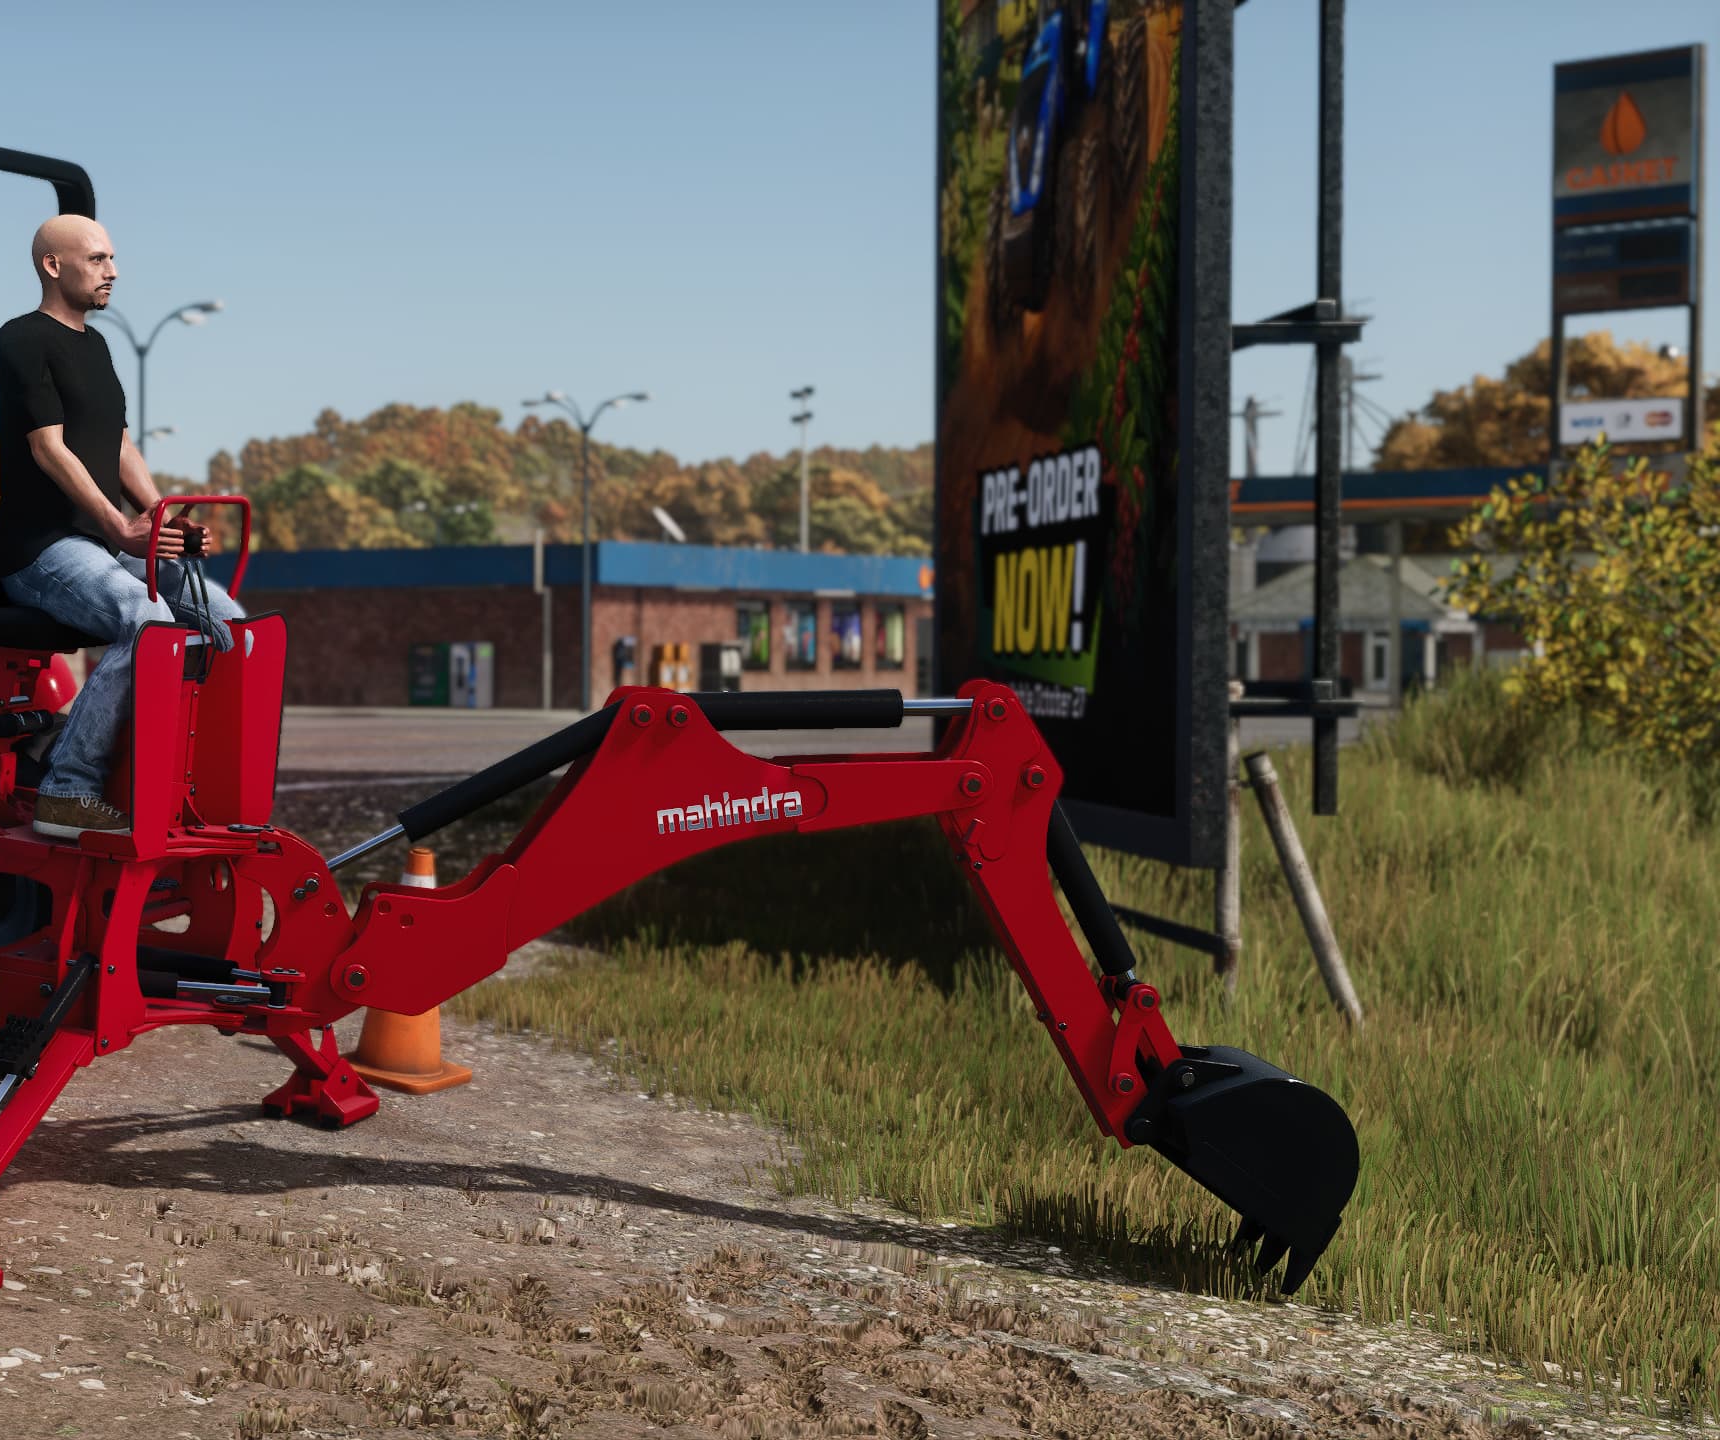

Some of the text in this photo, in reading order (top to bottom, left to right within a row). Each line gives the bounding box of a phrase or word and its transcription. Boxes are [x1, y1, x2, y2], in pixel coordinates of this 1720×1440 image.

[981, 446, 1101, 535] PRE-ORDER
[993, 540, 1086, 654] NOW!
[656, 786, 803, 835] mahindra
